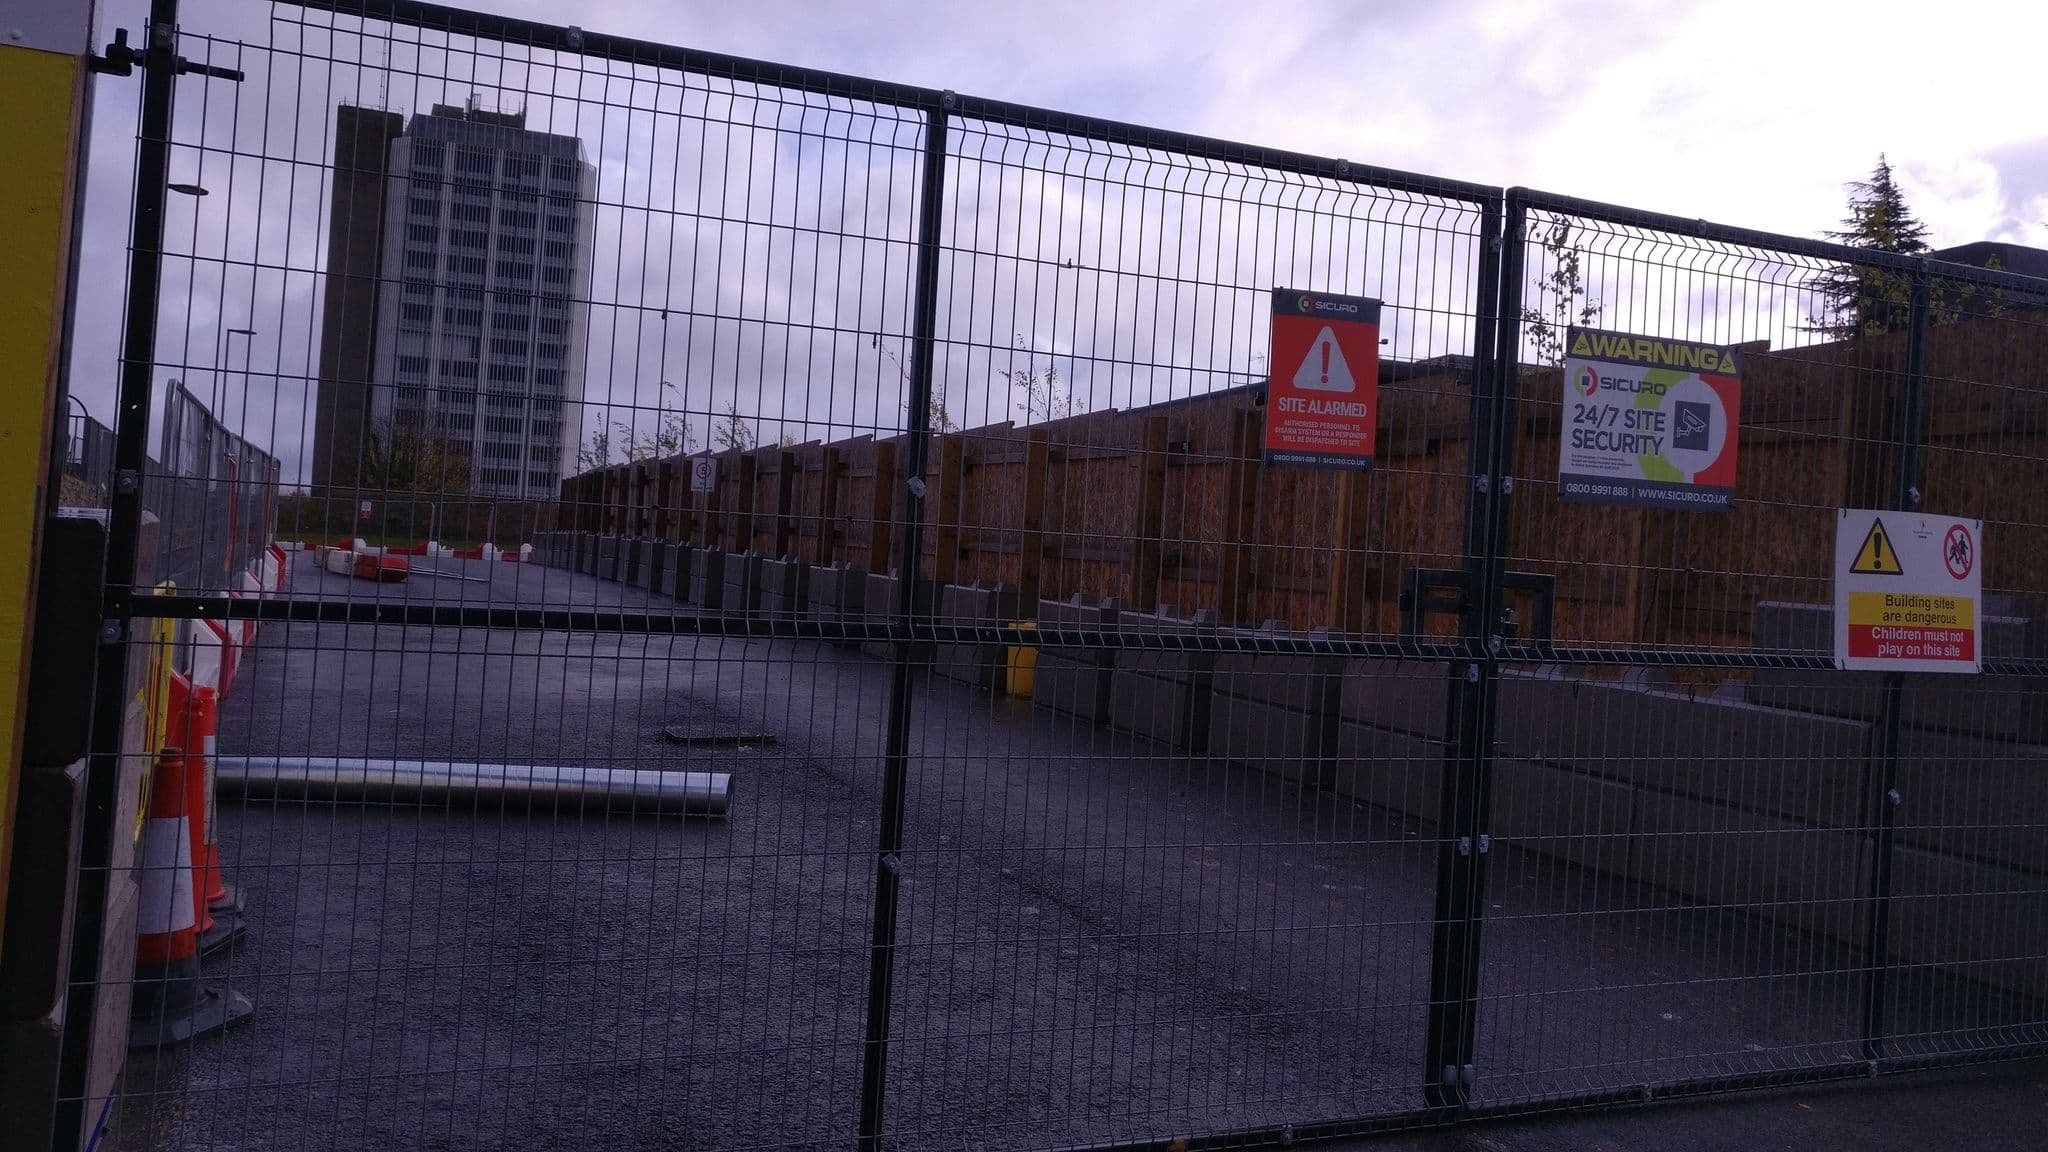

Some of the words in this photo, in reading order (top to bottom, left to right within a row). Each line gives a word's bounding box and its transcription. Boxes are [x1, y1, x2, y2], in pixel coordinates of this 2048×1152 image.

[1315, 301, 1358, 313] SICURO
[1591, 333, 1719, 370] WARNING
[1600, 376, 1667, 396] SICURO
[1278, 396, 1306, 413] SITE
[1308, 398, 1367, 417] ALARMED
[1283, 419, 1319, 428] AUTHORISED
[1573, 403, 1619, 428] 24/7
[1624, 408, 1666, 432] SITE
[1298, 428, 1321, 437] SYSTEM
[1571, 428, 1664, 456] SECURITY
[1566, 483, 1590, 494] 0800
[1638, 487, 1728, 504] WWW.SICURO.CO.UK
[1885, 594, 1932, 611] Building
[1933, 597, 1955, 610] sites
[1882, 611, 1901, 622] are
[1904, 610, 1957, 626] dangerous
[1871, 626, 1922, 641] Children
[1924, 630, 1948, 642] must
[1950, 631, 1964, 642] not
[1878, 643, 1903, 658] play
[1906, 645, 1920, 655] on
[1923, 643, 1942, 656] this
[1944, 645, 1961, 657] site
